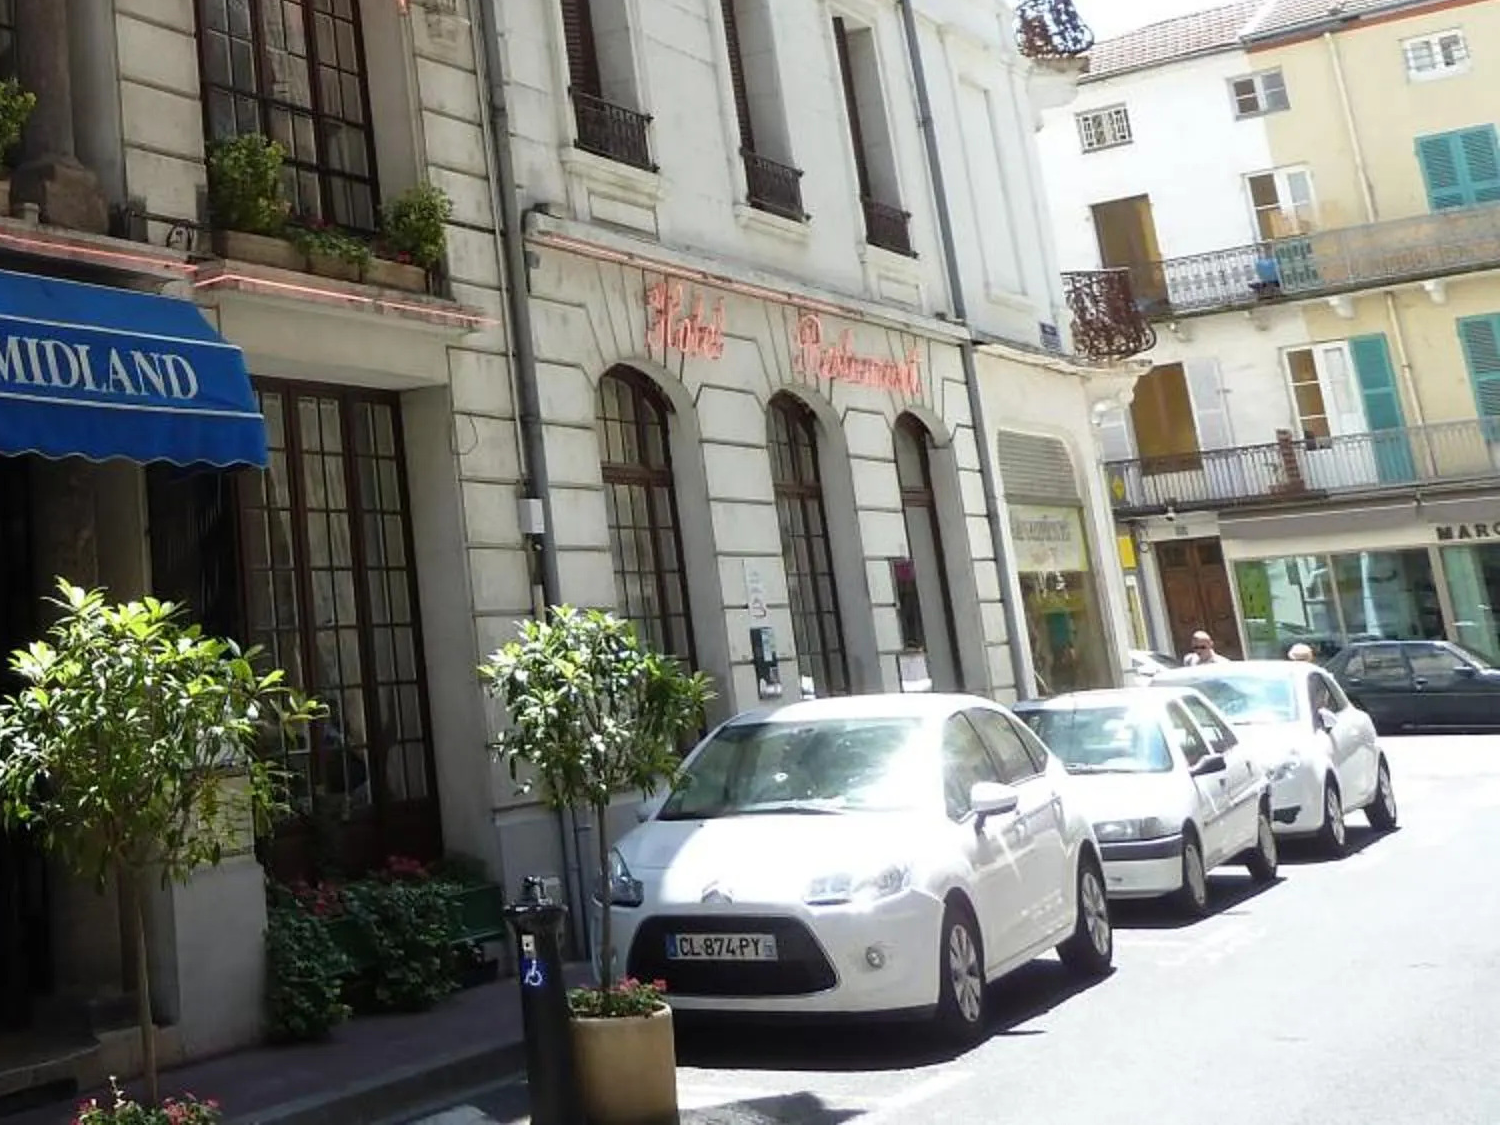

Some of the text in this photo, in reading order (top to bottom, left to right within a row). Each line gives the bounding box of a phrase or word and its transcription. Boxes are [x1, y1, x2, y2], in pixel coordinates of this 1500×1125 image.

[680, 937, 701, 956] CL
[704, 938, 735, 956] 874
[739, 938, 760, 956] PY
